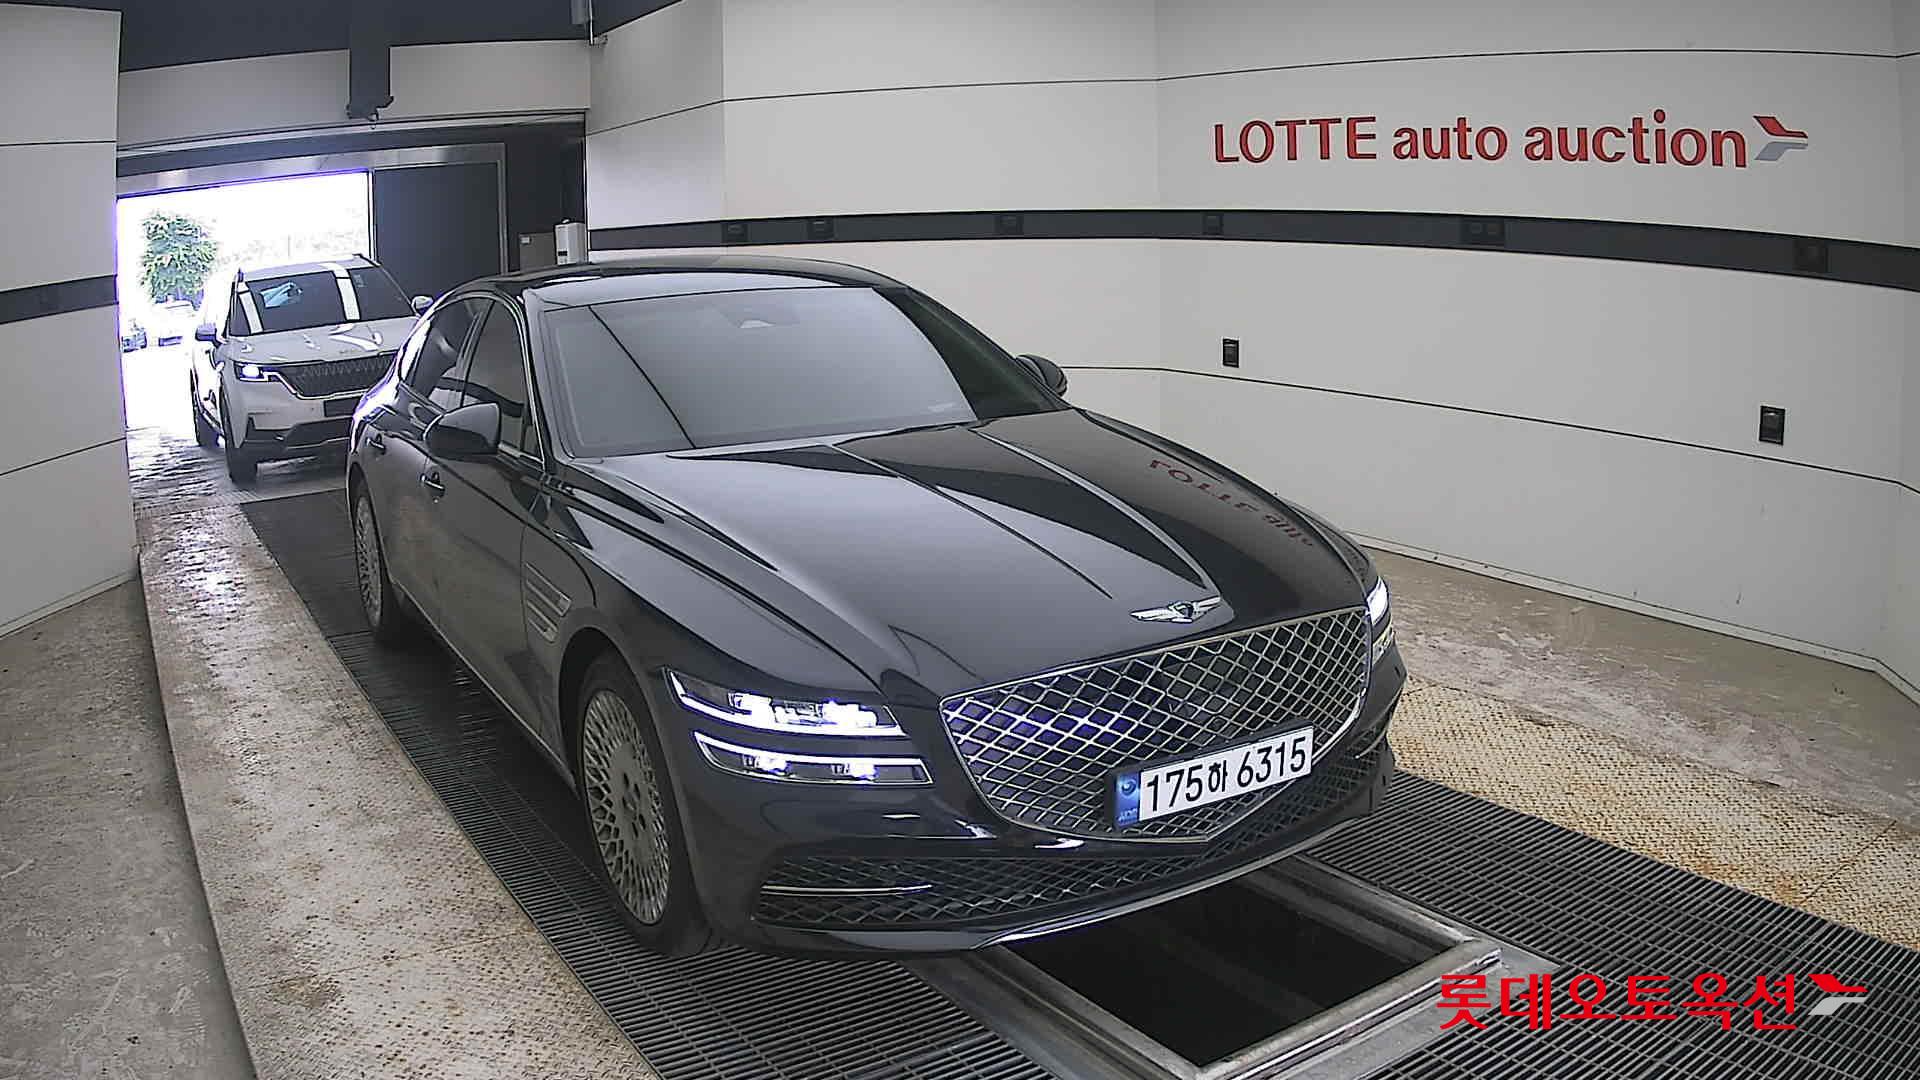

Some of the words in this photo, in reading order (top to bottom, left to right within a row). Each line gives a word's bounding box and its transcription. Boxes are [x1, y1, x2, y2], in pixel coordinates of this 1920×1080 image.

[1214, 116, 1377, 163] LOTTE
[1392, 116, 1508, 161] auto
[1523, 109, 1748, 168] auction
[1146, 760, 1228, 812] 175하
[1237, 736, 1307, 788] 6315
